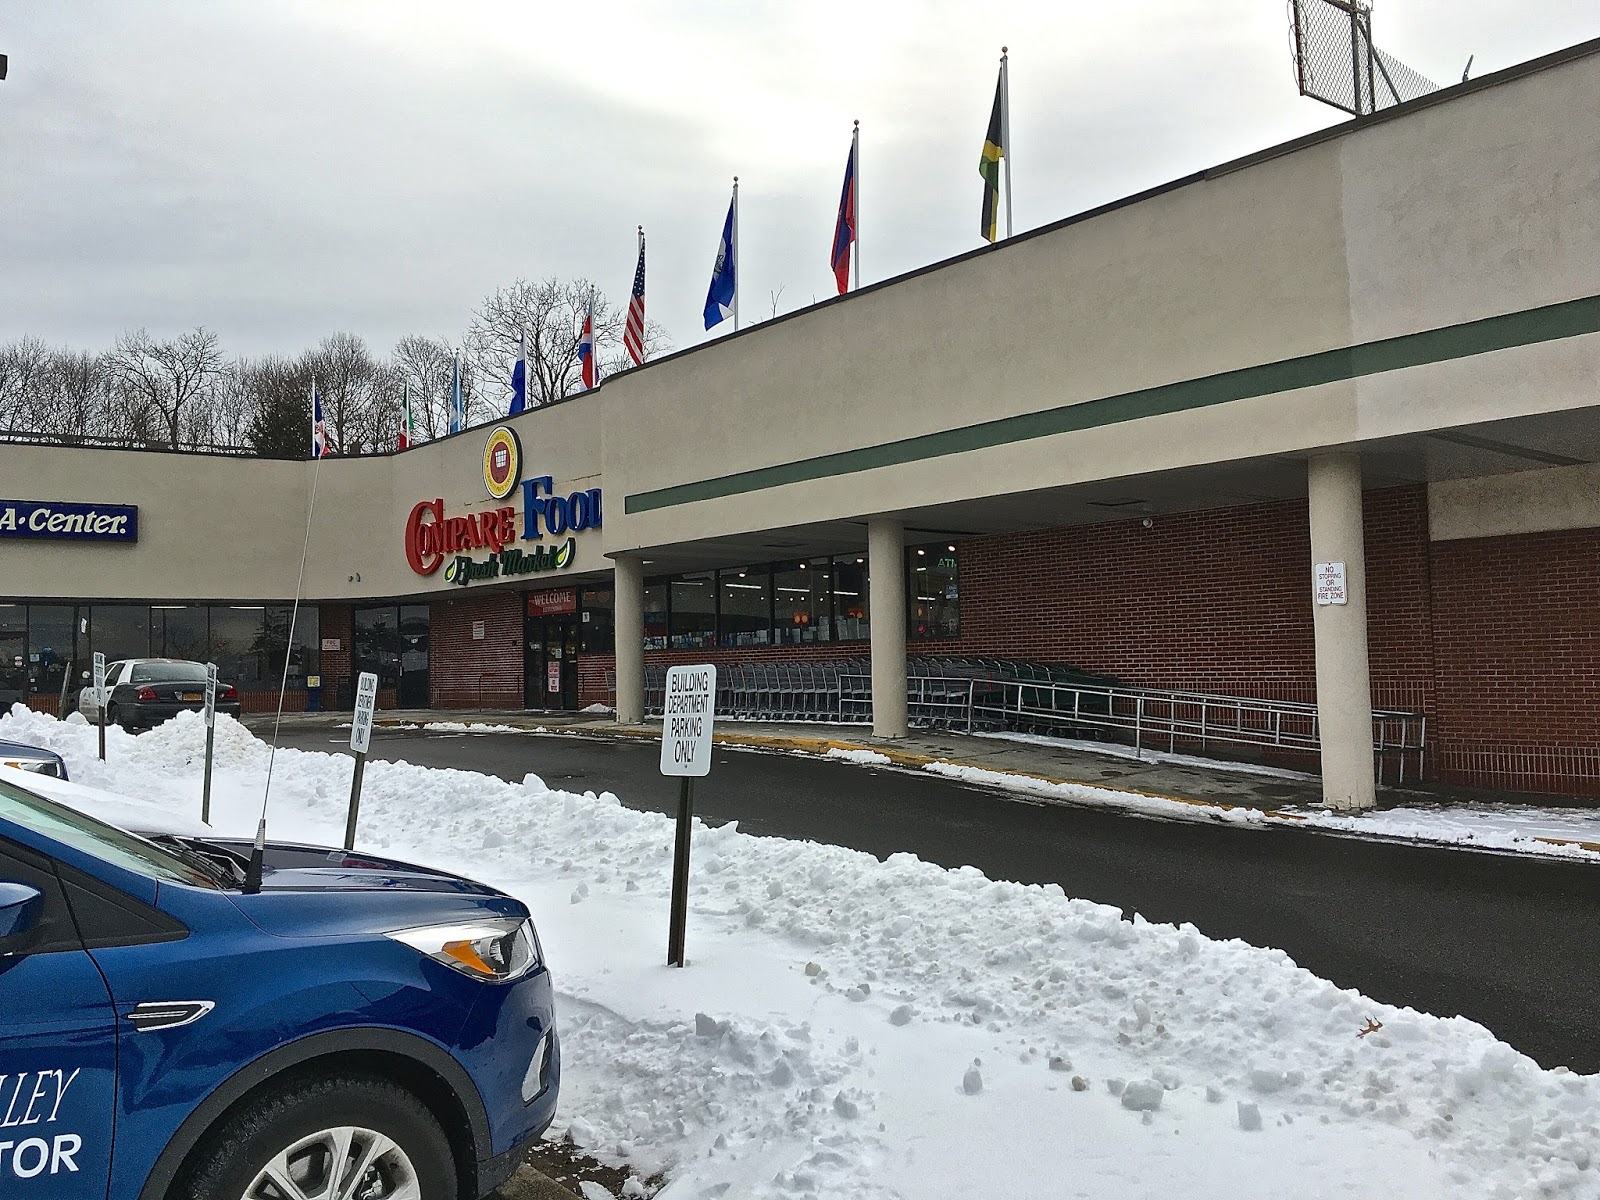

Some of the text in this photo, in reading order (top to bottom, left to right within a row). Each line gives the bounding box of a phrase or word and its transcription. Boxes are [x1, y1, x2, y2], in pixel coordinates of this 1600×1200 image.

[405, 499, 516, 576] COMPARE
[458, 545, 558, 585] Fresh Market
[534, 591, 571, 606] WELCOME
[671, 672, 708, 693] BUILDING
[668, 694, 709, 713] DEPARTMENT
[670, 717, 702, 738] PARKING
[674, 740, 697, 762] ONLY
